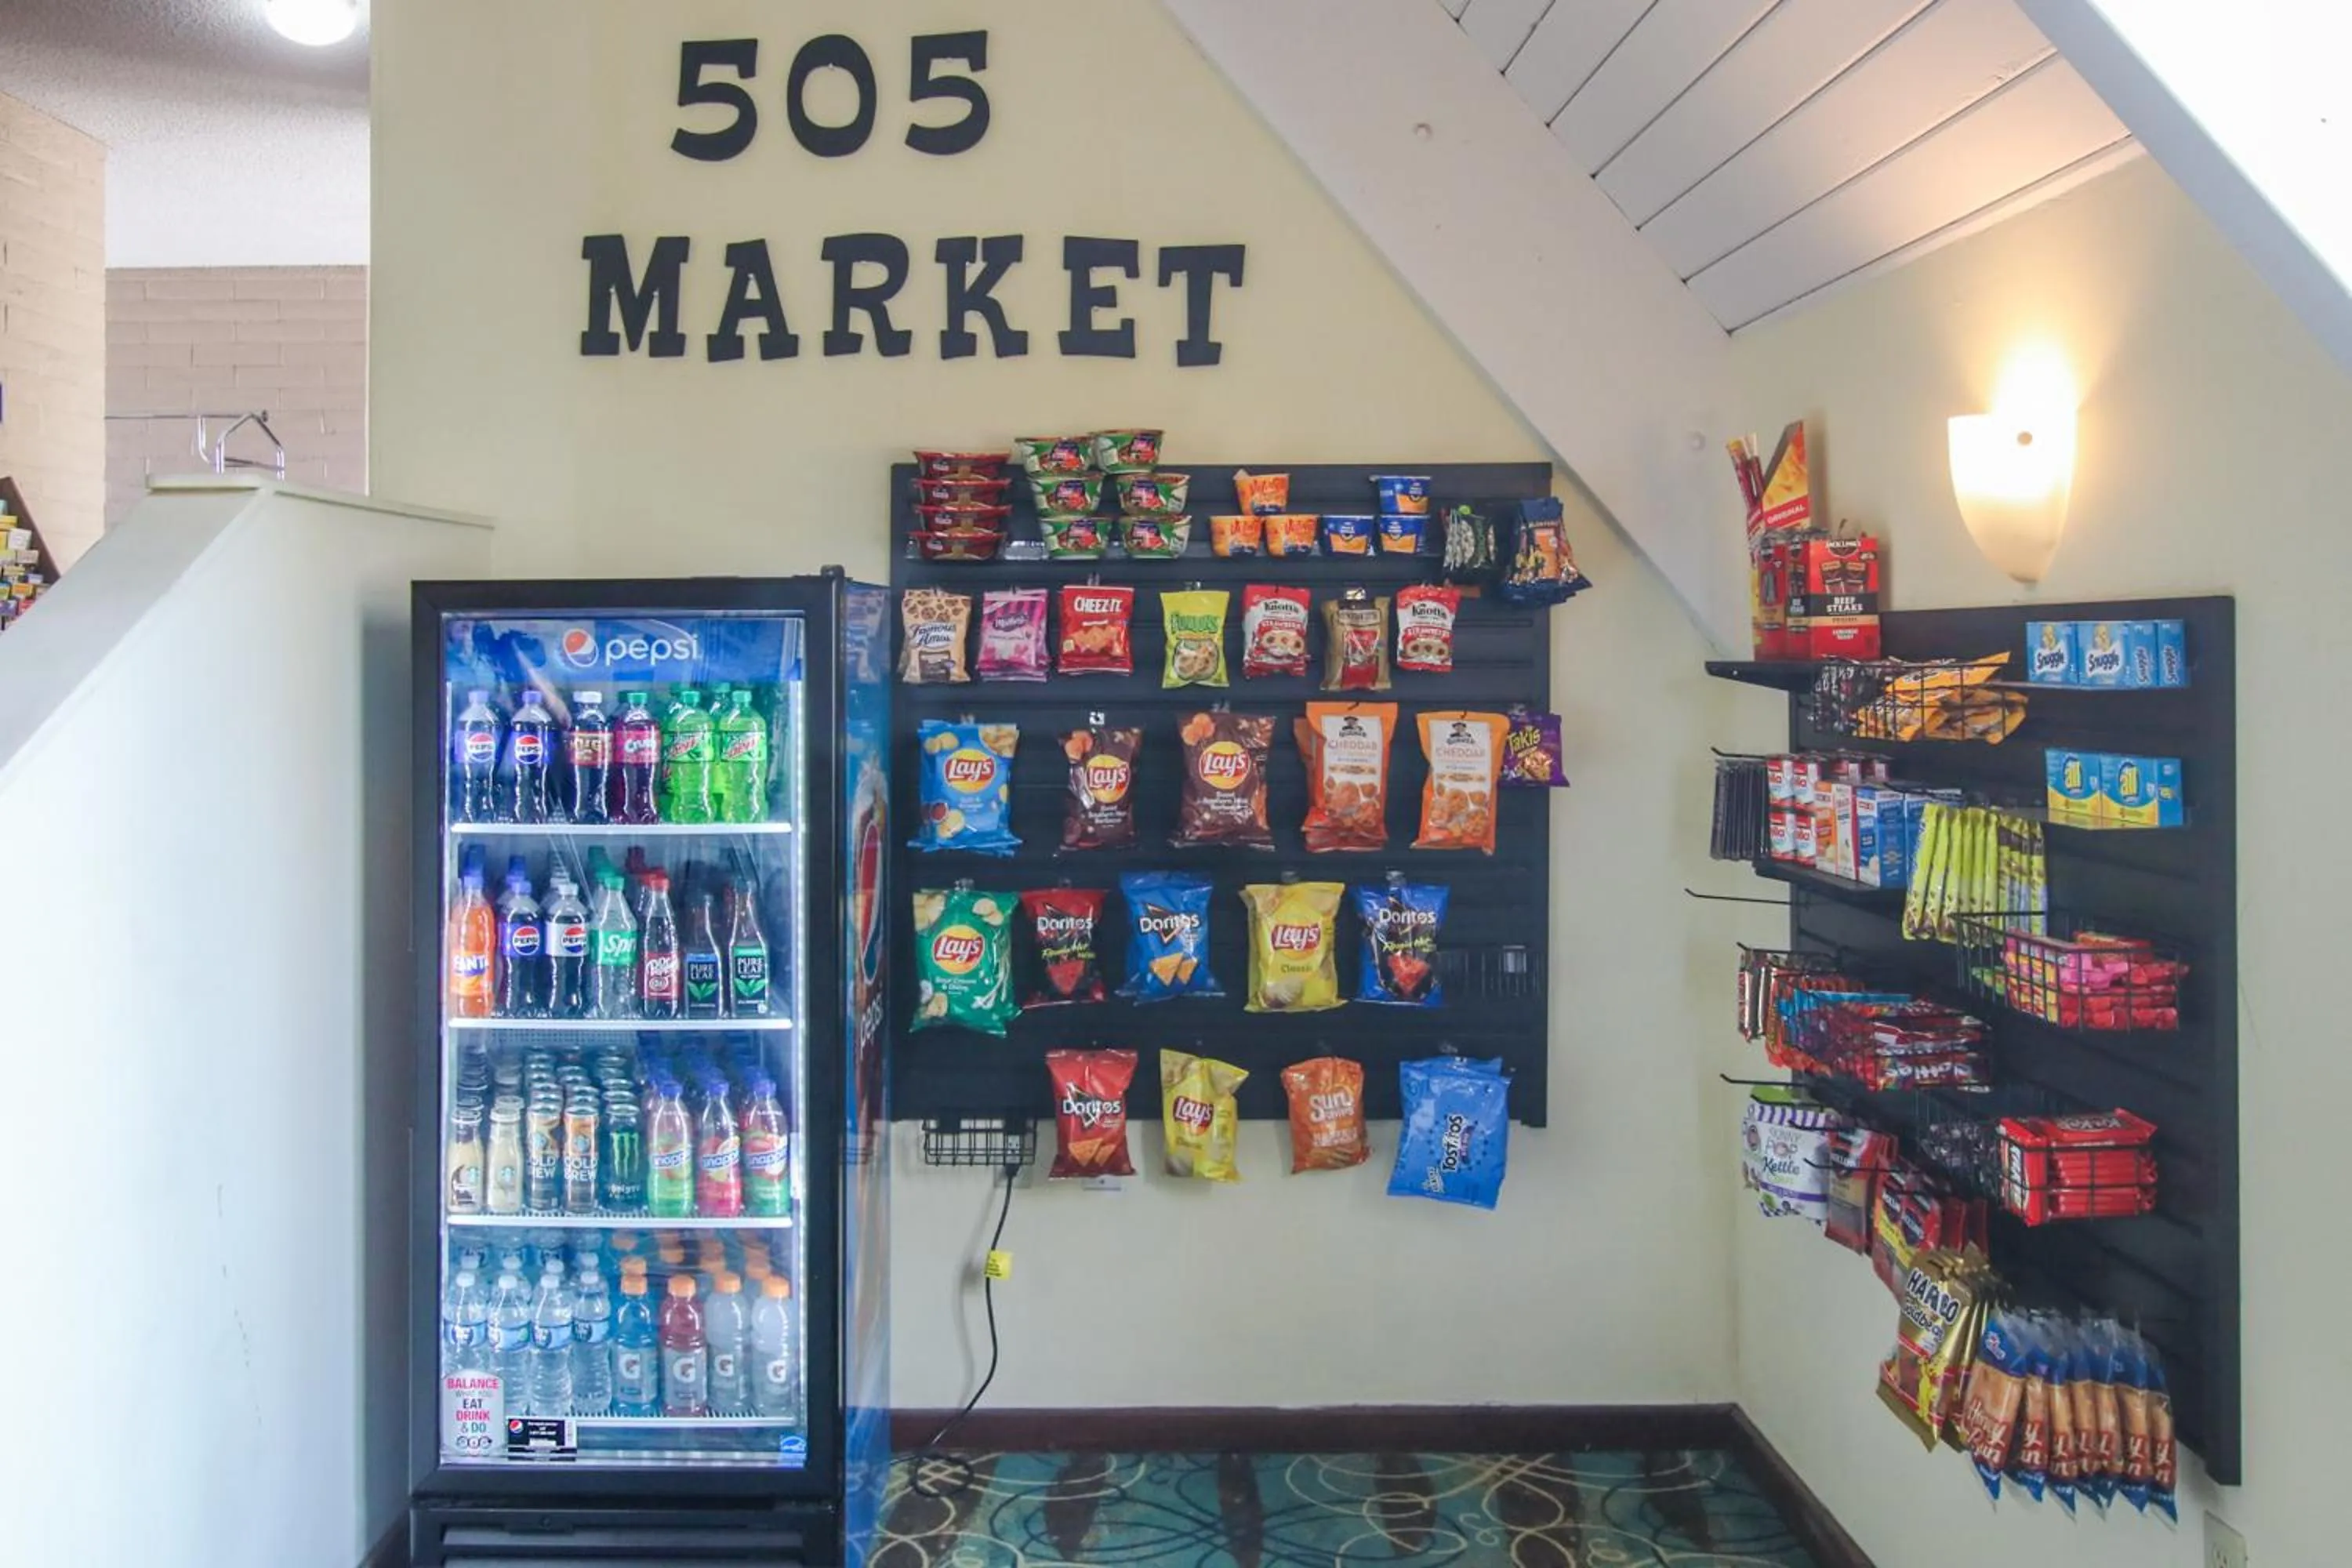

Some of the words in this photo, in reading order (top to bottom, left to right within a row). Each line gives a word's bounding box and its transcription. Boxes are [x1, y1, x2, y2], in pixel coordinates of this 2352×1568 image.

[671, 30, 990, 162] 505
[580, 233, 1245, 367] MARKET
[605, 633, 699, 666] pepsi
[1507, 727, 1542, 755] Takis
[948, 758, 993, 782] Lay's
[1202, 753, 1247, 777] Lay's
[1089, 766, 1127, 789] Lay's
[1037, 916, 1094, 931] Doritos
[1139, 913, 1200, 933] Doritos
[1379, 908, 1436, 924] Doritos
[1275, 924, 1319, 951] Lay's
[936, 935, 982, 960] Lay's
[690, 964, 714, 973] PURE
[738, 957, 764, 967] PURE
[738, 966, 763, 975] LEAF
[1062, 1098, 1121, 1115] Doritos
[1176, 1098, 1214, 1127] Lay's
[564, 1156, 599, 1169] COLD
[445, 1377, 499, 1389] BALANCE
[463, 1398, 483, 1409] EAT
[456, 1410, 490, 1421] DRINK
[470, 1422, 487, 1433] DO
